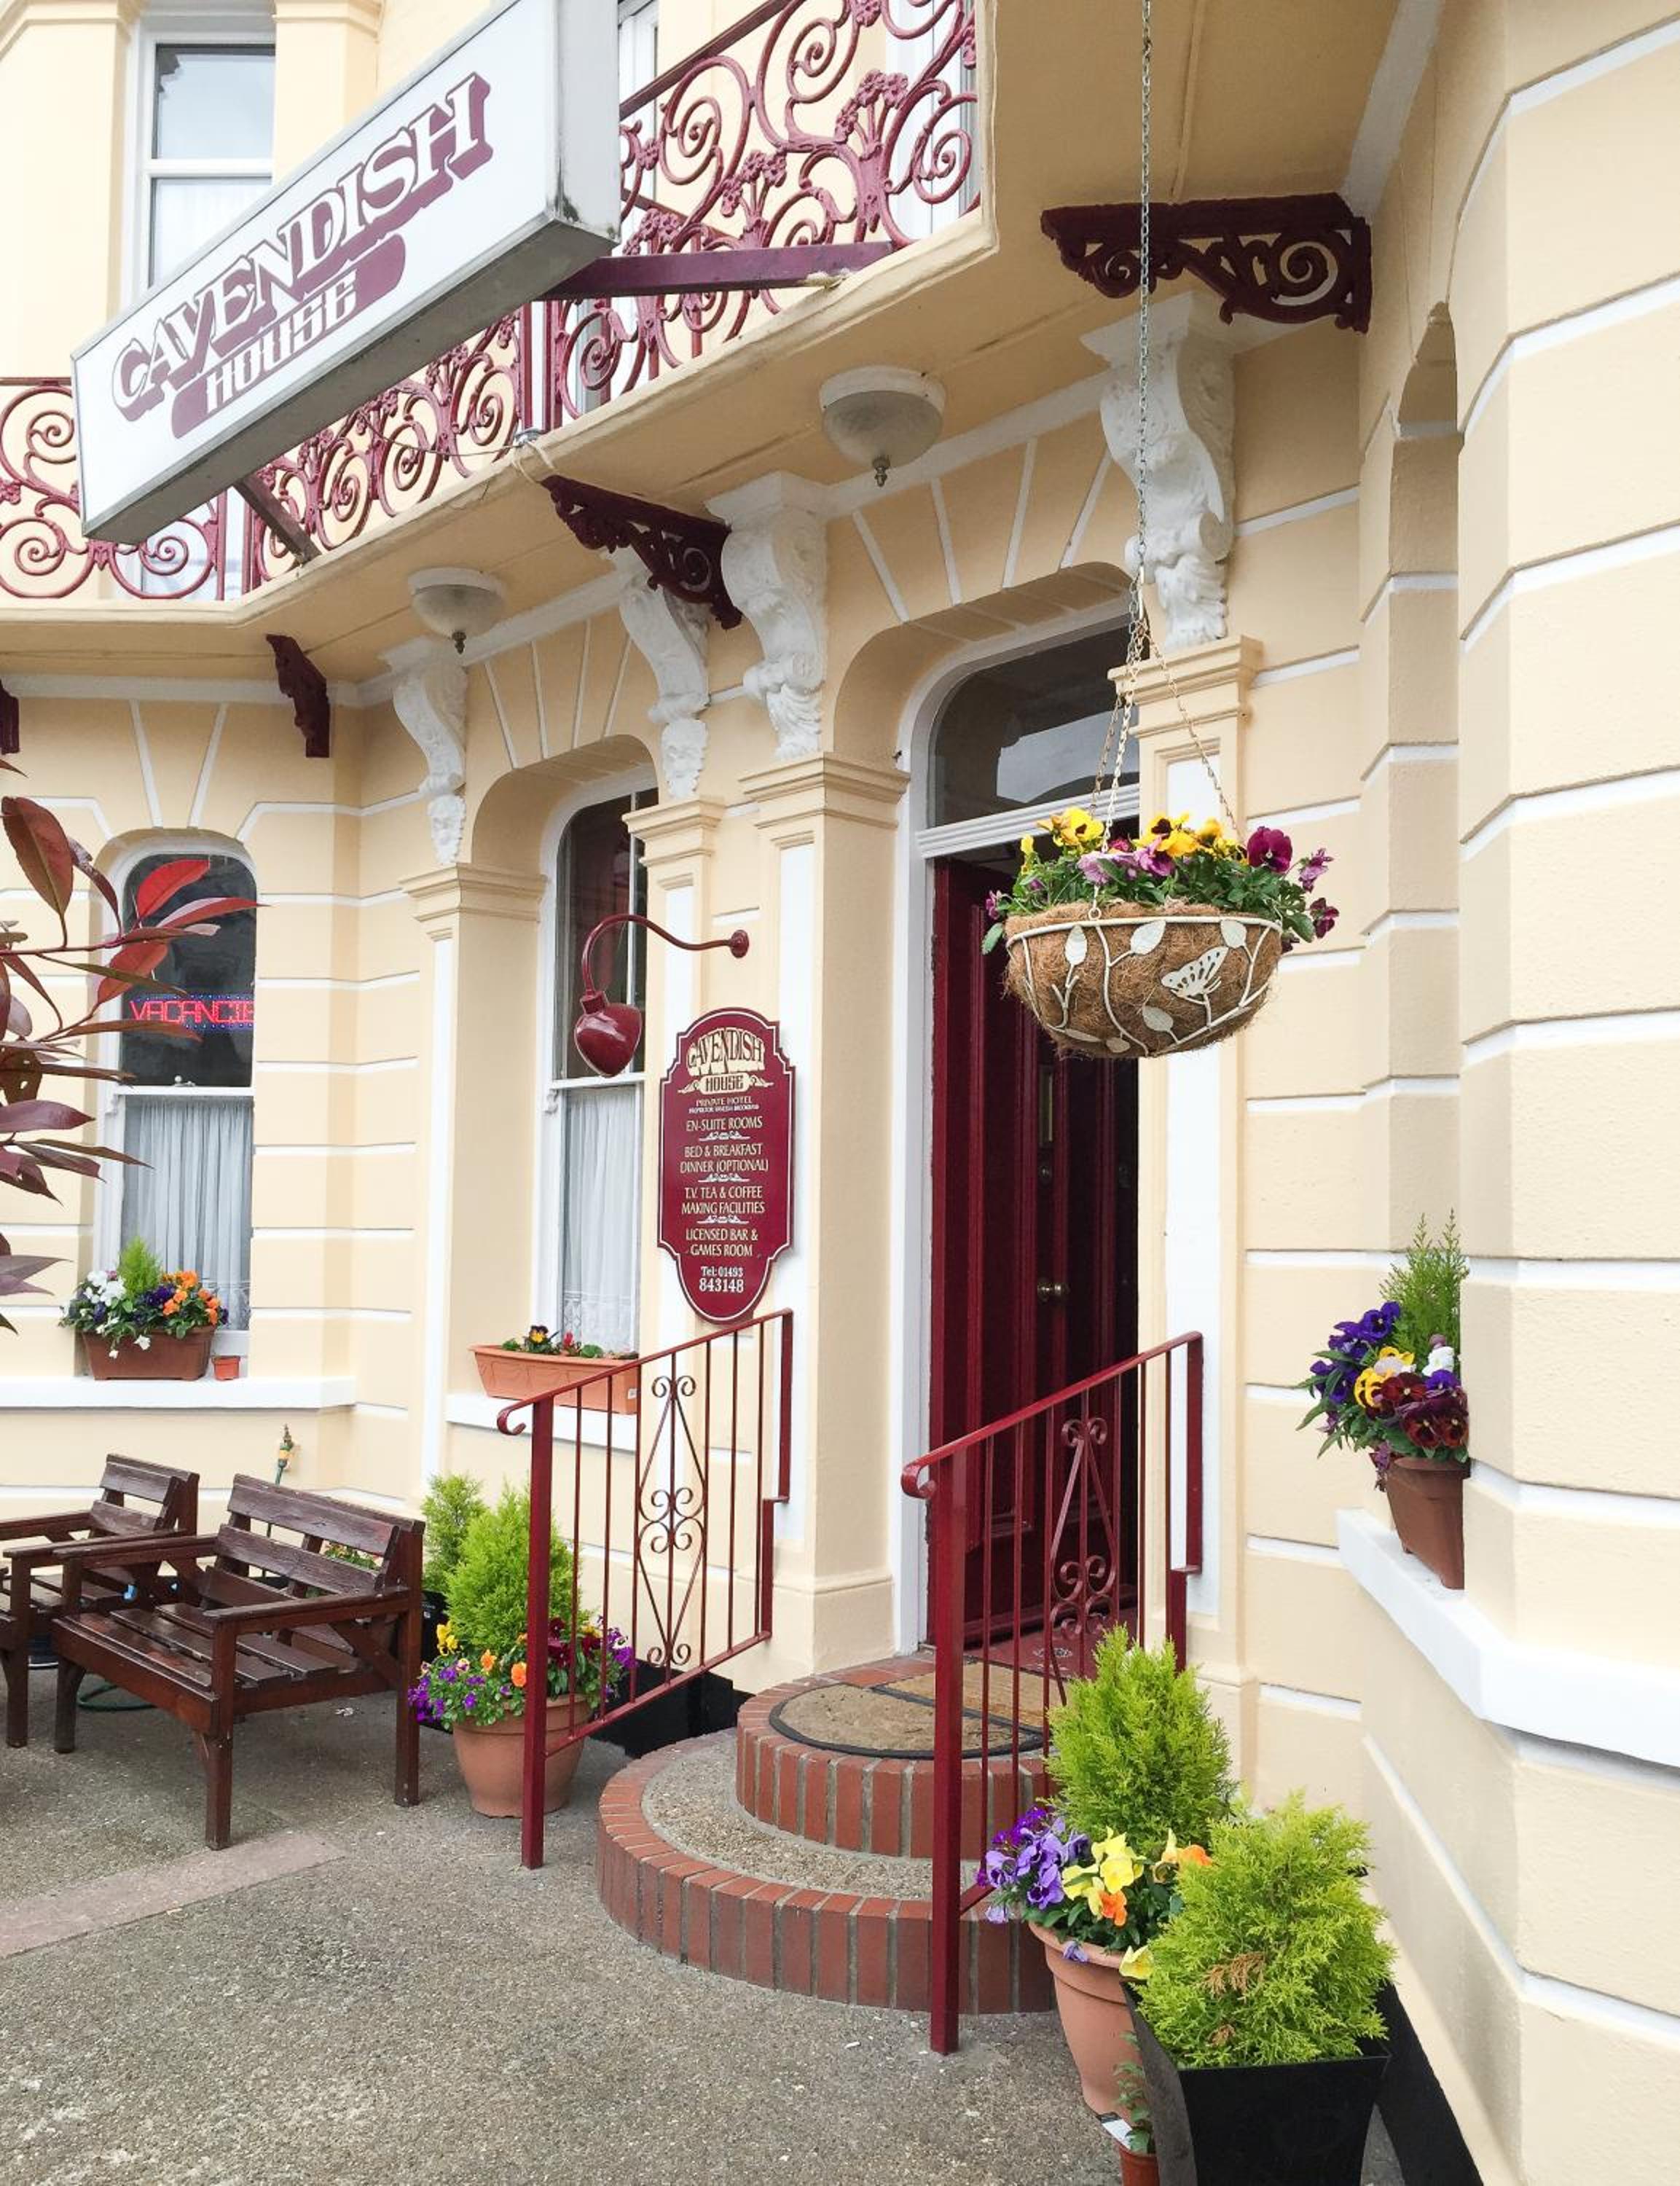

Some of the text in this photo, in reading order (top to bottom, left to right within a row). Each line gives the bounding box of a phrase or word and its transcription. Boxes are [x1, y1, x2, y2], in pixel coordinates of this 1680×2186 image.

[111, 71, 492, 421] CAVENDISH
[206, 270, 358, 414] HOUSE
[687, 1027, 765, 1076] CAVENDISH
[704, 1075, 745, 1092] HOUSE
[696, 1095, 753, 1107] PRIVATE HOTEL
[686, 1116, 763, 1131] EN-SUITE ROOMS
[684, 1143, 764, 1158] BED & BREAKFAST
[680, 1159, 769, 1174] DINNER (OPTIONAL)
[701, 1187, 718, 1199] TEA
[719, 1187, 726, 1198] &
[728, 1186, 763, 1199] COFFEE
[681, 1202, 765, 1215] MAKING FACILITIES
[686, 1229, 758, 1241] LICENSED BAR &
[690, 1244, 753, 1256] GAMES ROOM
[699, 1277, 744, 1293] 843148
